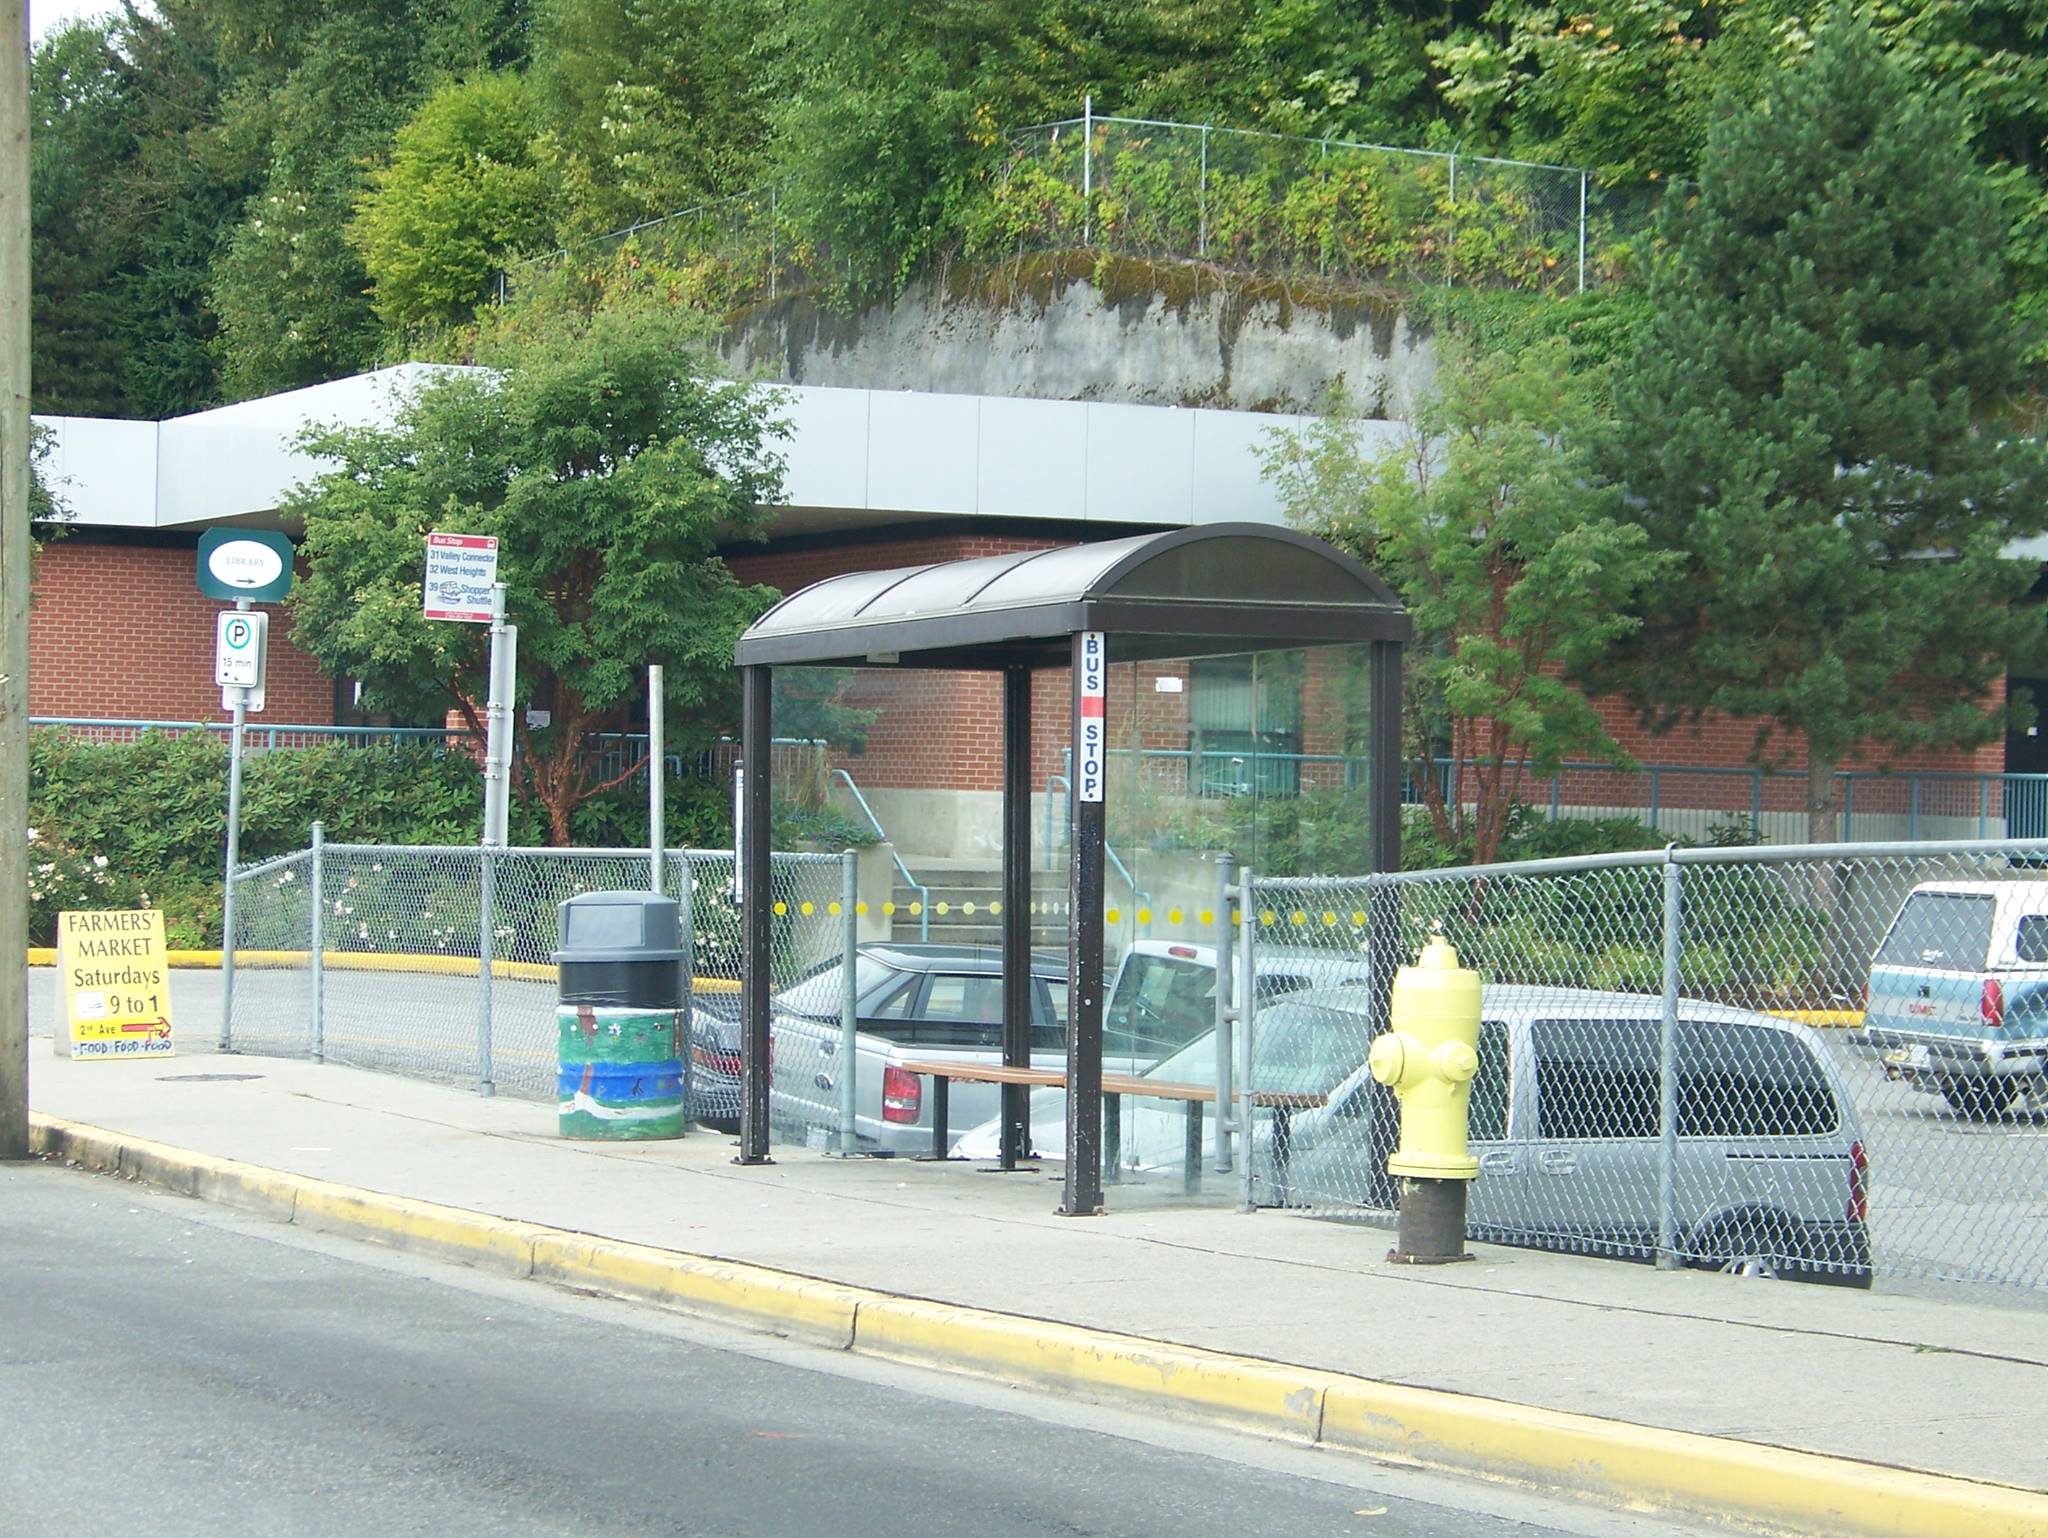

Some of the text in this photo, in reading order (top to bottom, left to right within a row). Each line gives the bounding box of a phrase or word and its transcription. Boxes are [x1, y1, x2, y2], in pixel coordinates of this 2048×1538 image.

[447, 537, 464, 546] Stop
[226, 556, 265, 567] LIBRARY
[430, 550, 495, 562] 31 Valley Connector
[429, 564, 487, 578] 32 West Heights
[233, 625, 245, 642] P
[223, 657, 252, 668] 15 min
[1084, 640, 1099, 793] BUS STOP
[69, 912, 156, 932] FARMERS'
[78, 937, 152, 957] MARKET
[74, 965, 160, 989] Saturdays
[110, 995, 158, 1014] 9 to 1
[99, 1024, 116, 1035] Ave
